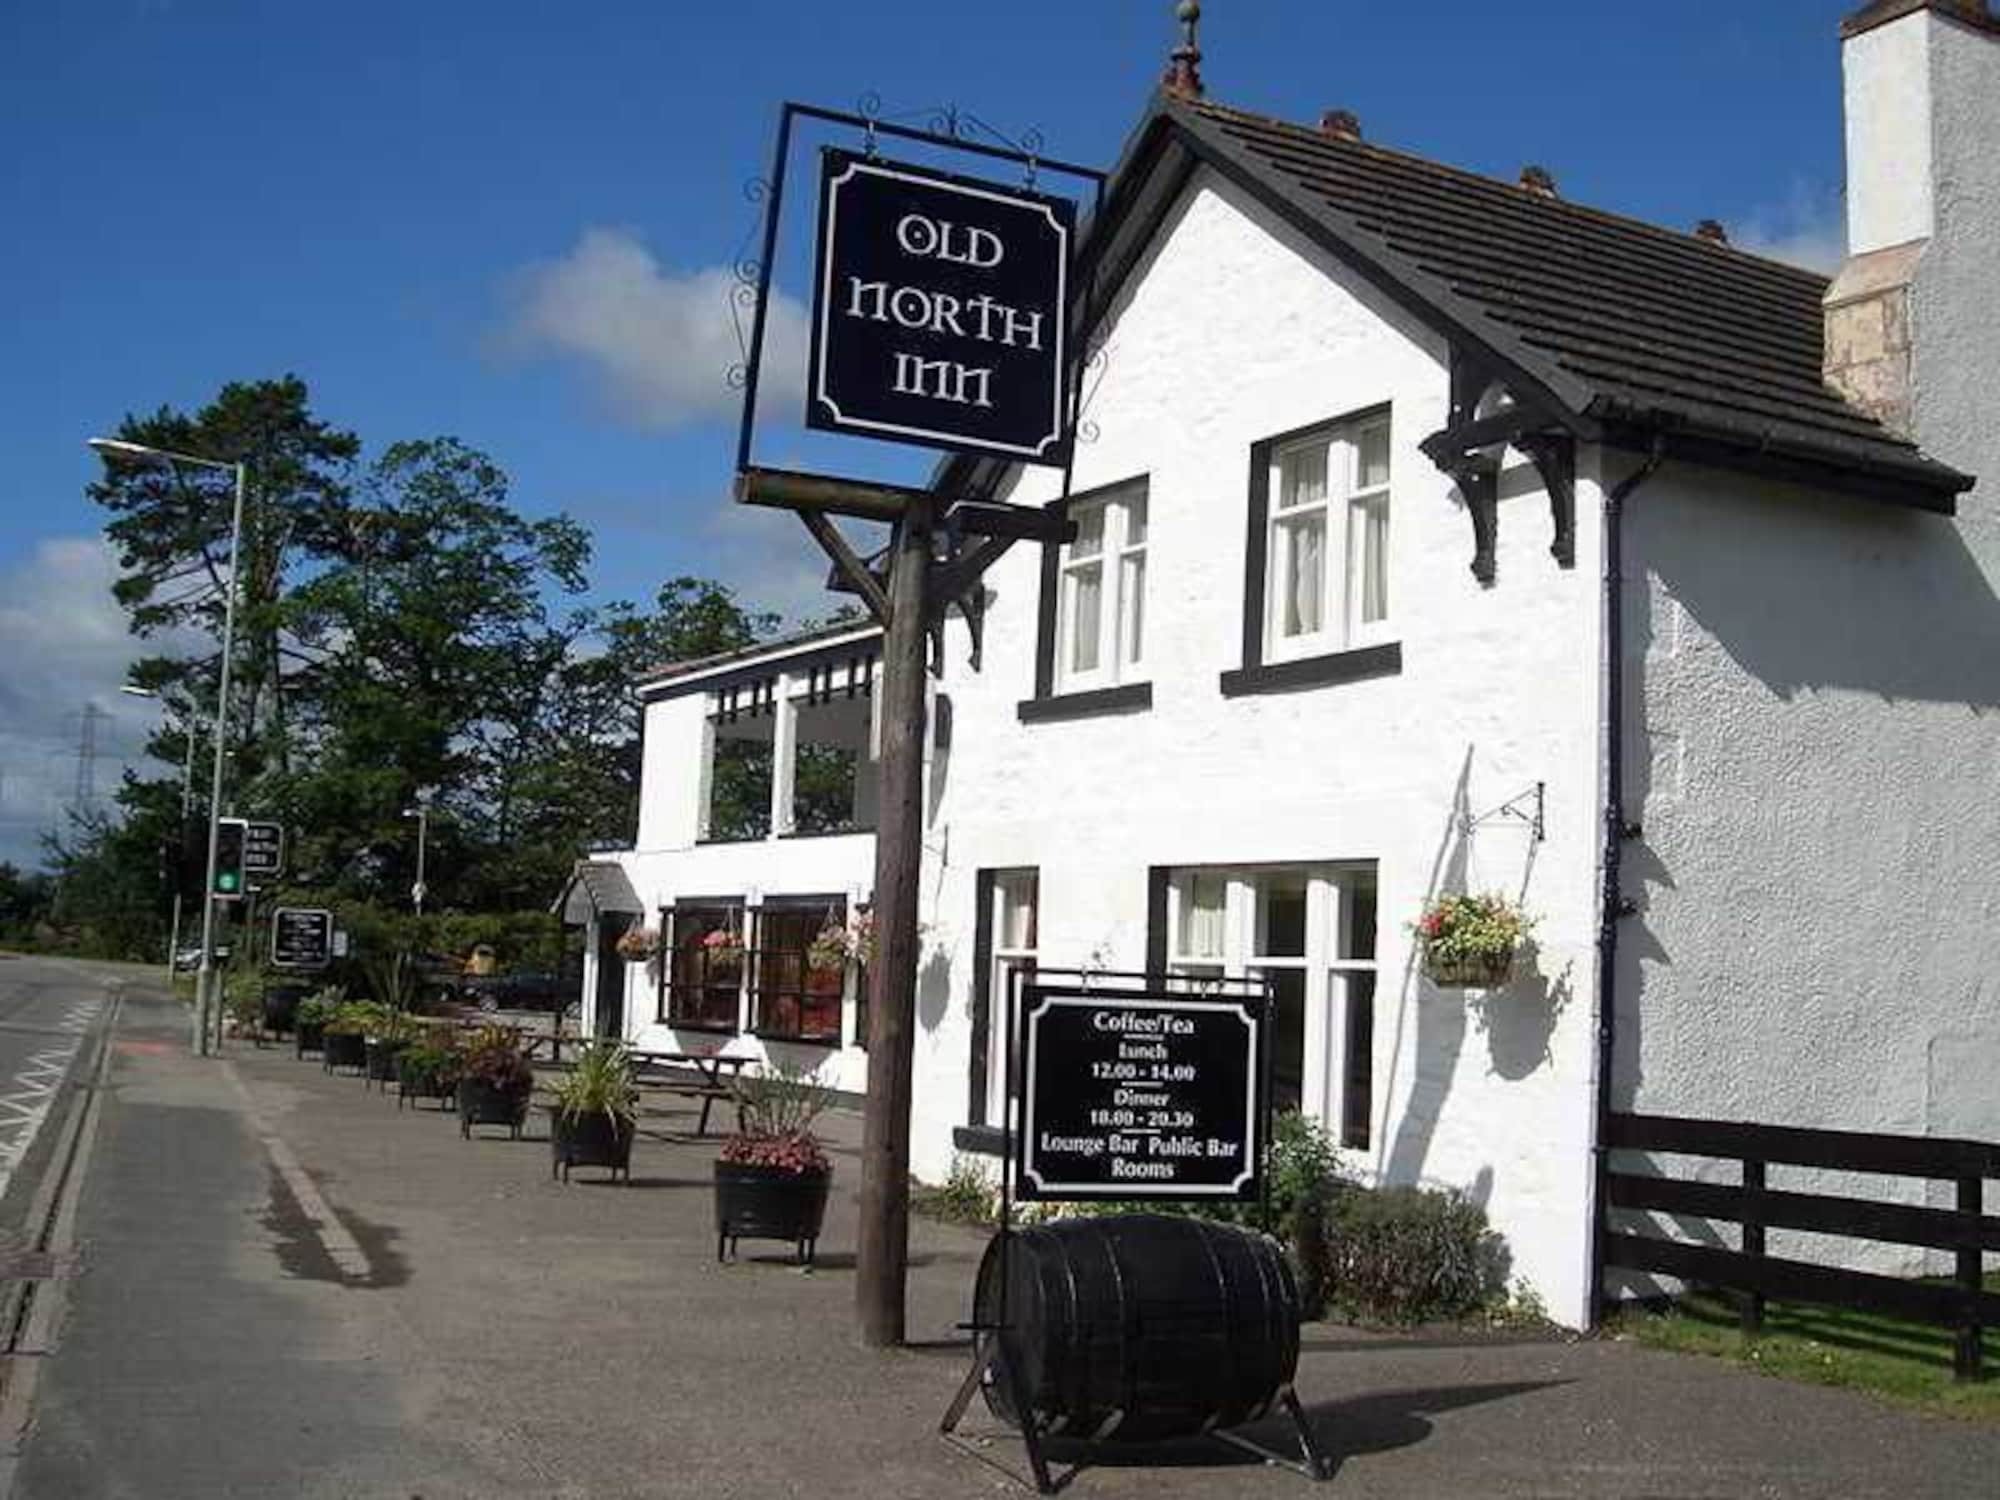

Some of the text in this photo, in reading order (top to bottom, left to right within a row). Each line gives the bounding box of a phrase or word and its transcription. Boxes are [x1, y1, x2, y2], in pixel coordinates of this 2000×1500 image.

[897, 214, 1003, 267] OLD
[1093, 1012, 1195, 1034] Coffee/Tea
[1119, 1043, 1168, 1059] Lunch
[1092, 1062, 1136, 1078] 12.00
[1151, 1064, 1195, 1081] 14.00
[1114, 1089, 1170, 1107] Dinner
[1148, 1110, 1194, 1127] 20.30
[1041, 1132, 1238, 1156] Lounge Bar Public Bar
[1111, 1158, 1174, 1178] Rooms
